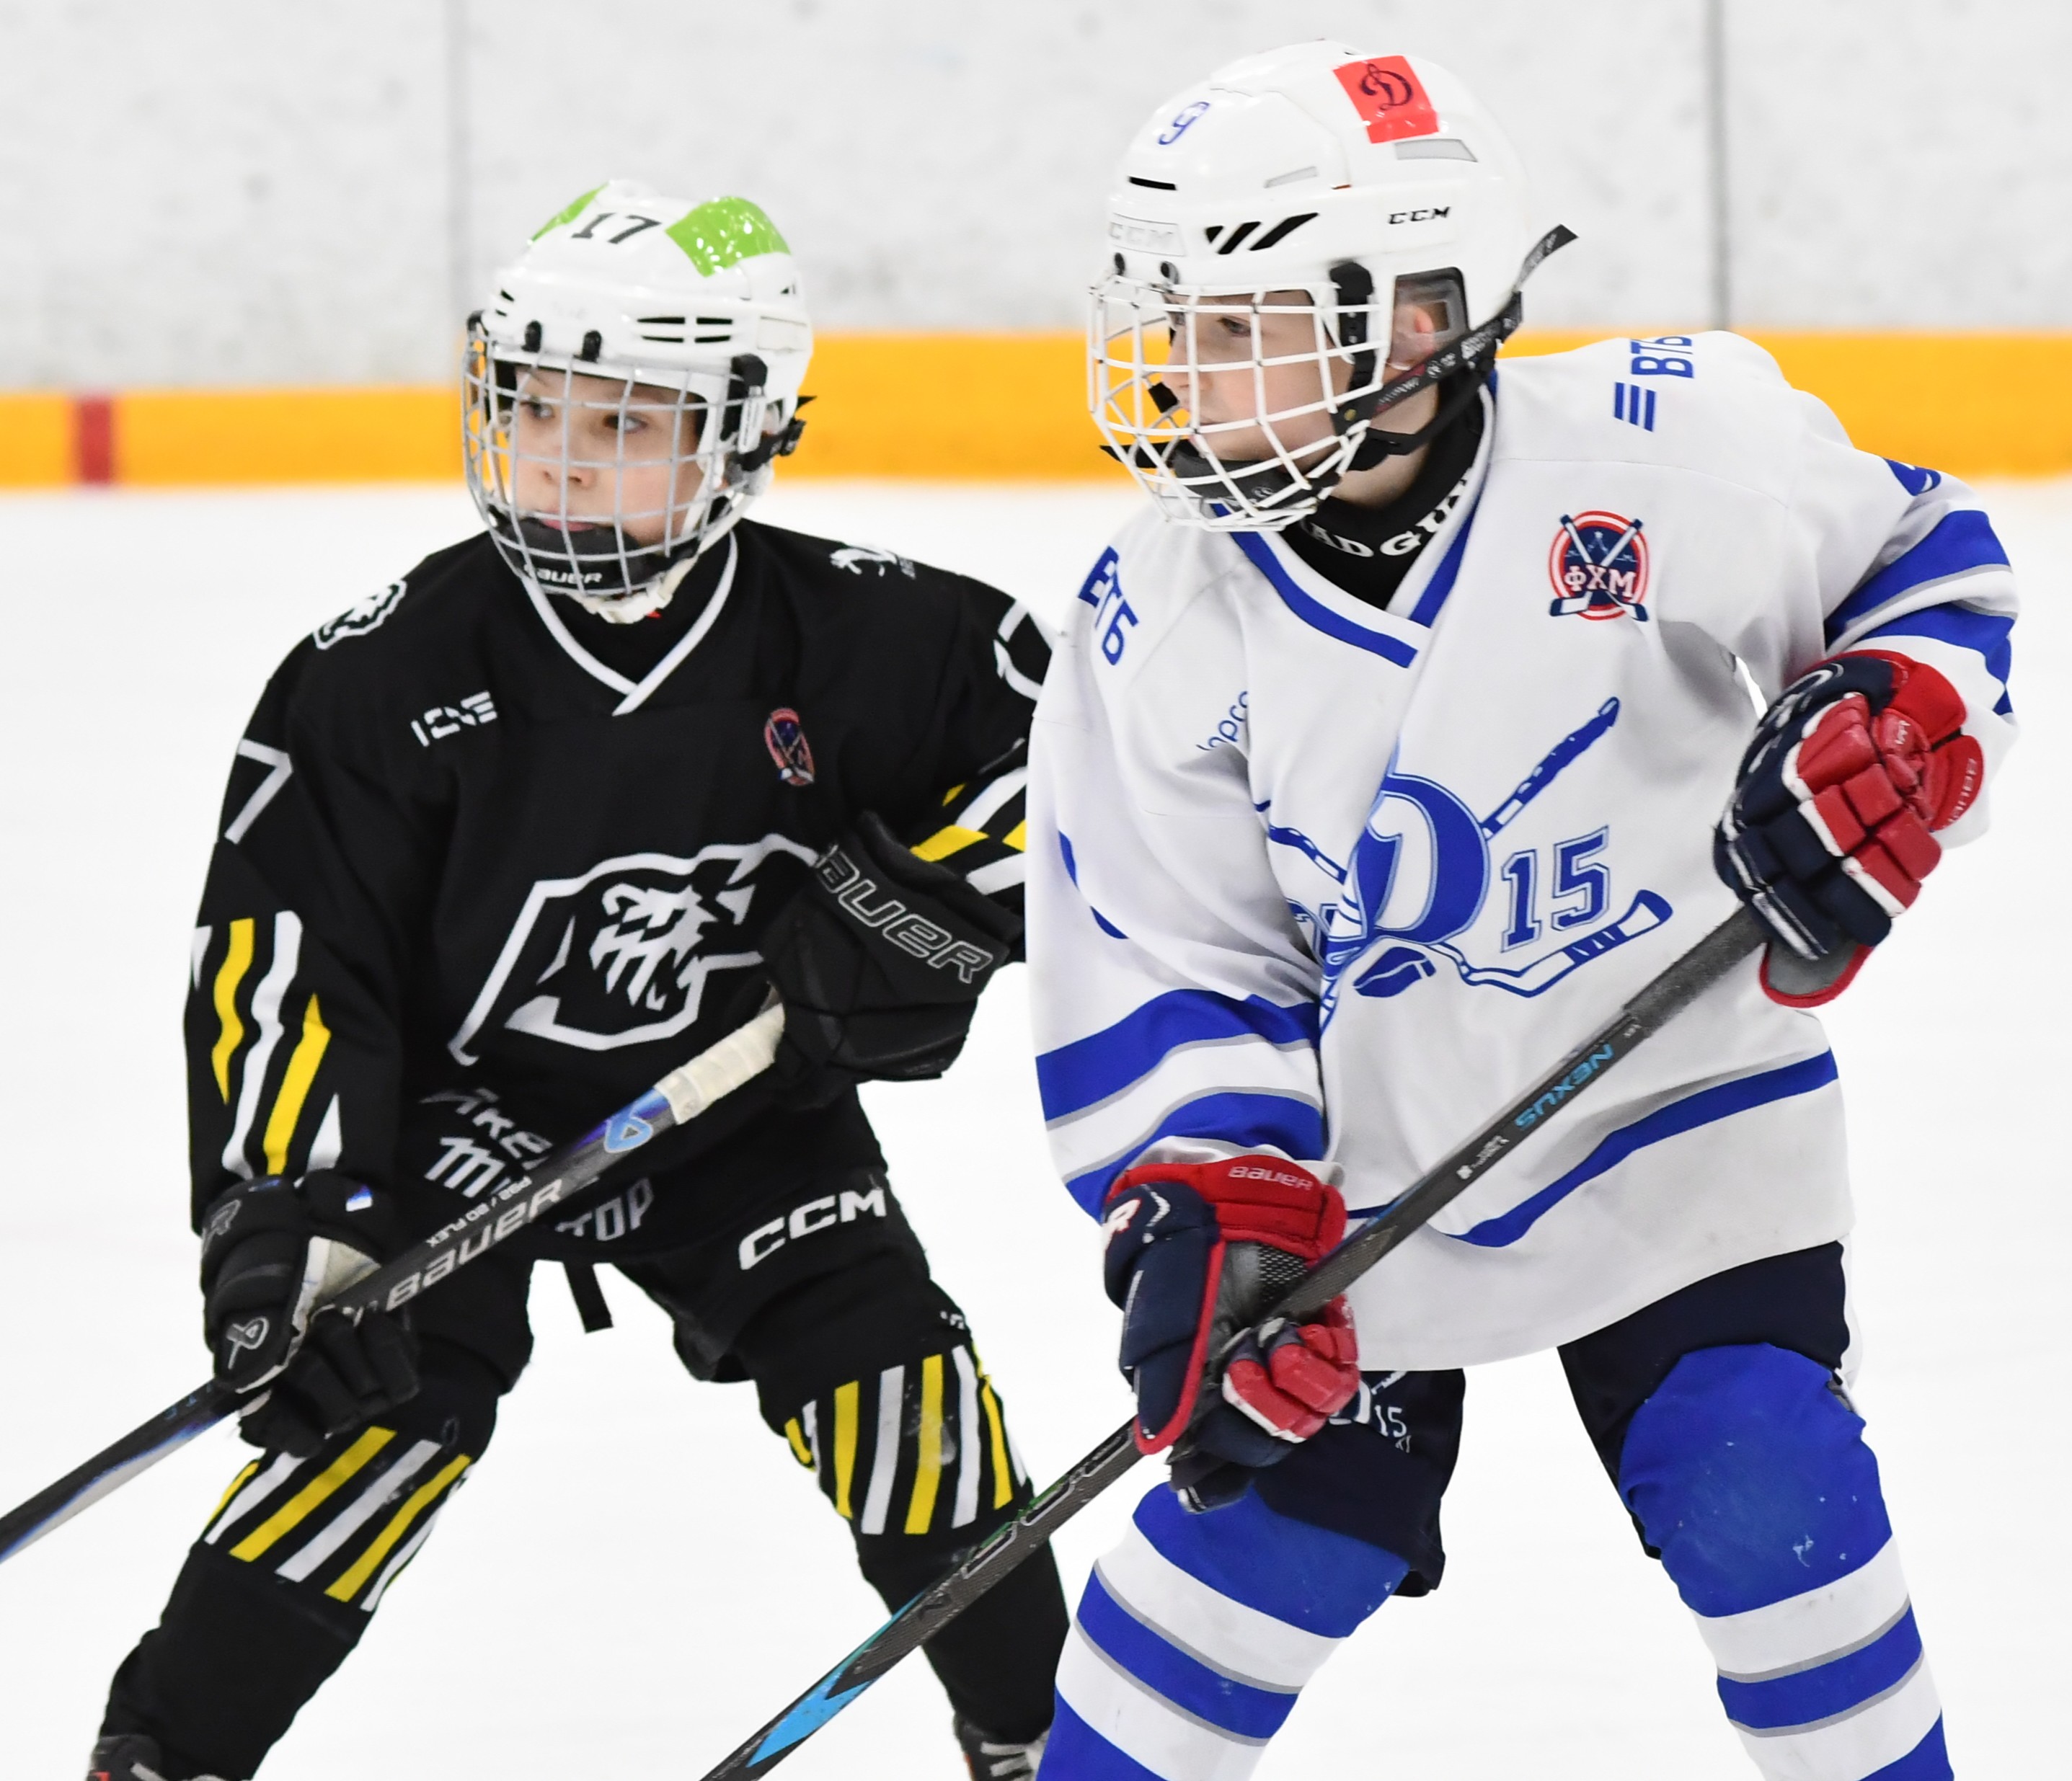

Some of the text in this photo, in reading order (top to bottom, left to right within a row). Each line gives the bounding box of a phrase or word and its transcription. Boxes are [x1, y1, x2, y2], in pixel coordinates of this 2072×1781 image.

[571, 212, 662, 244] 17
[1389, 206, 1451, 225] CCM
[1564, 565, 1637, 598] ФХМ
[815, 843, 994, 985] AUER
[1500, 824, 1611, 954] 15
[1514, 1043, 1615, 1131] NEXUS
[1228, 1165, 1314, 1191] BAUER
[386, 1178, 563, 1312] BAUER
[738, 1188, 886, 1270] CCM
[1374, 1405, 1407, 1437] 15
